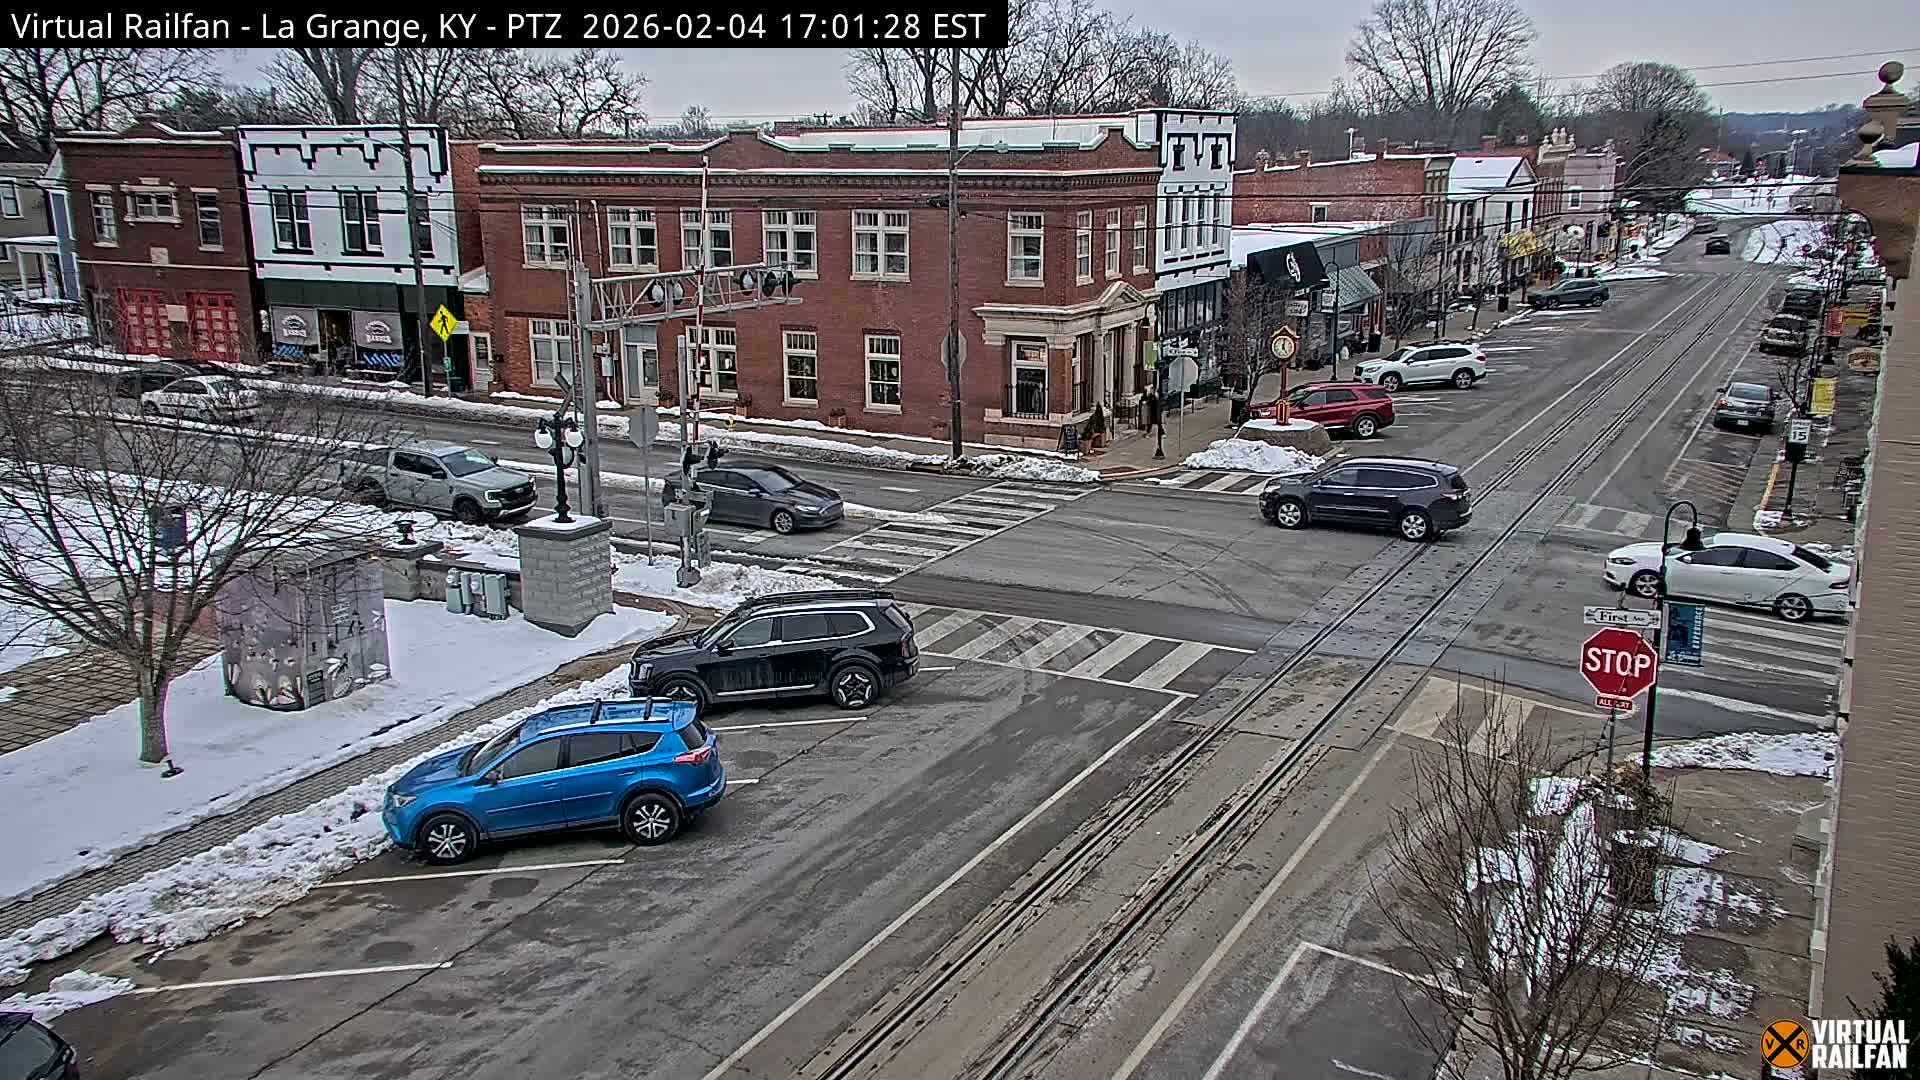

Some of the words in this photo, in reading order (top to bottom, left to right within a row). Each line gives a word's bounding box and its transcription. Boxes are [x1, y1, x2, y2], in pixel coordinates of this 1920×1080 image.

[1792, 431, 1807, 441] 15
[1599, 610, 1628, 622] First
[1585, 647, 1652, 678] STOP
[1598, 697, 1613, 707] ALL
